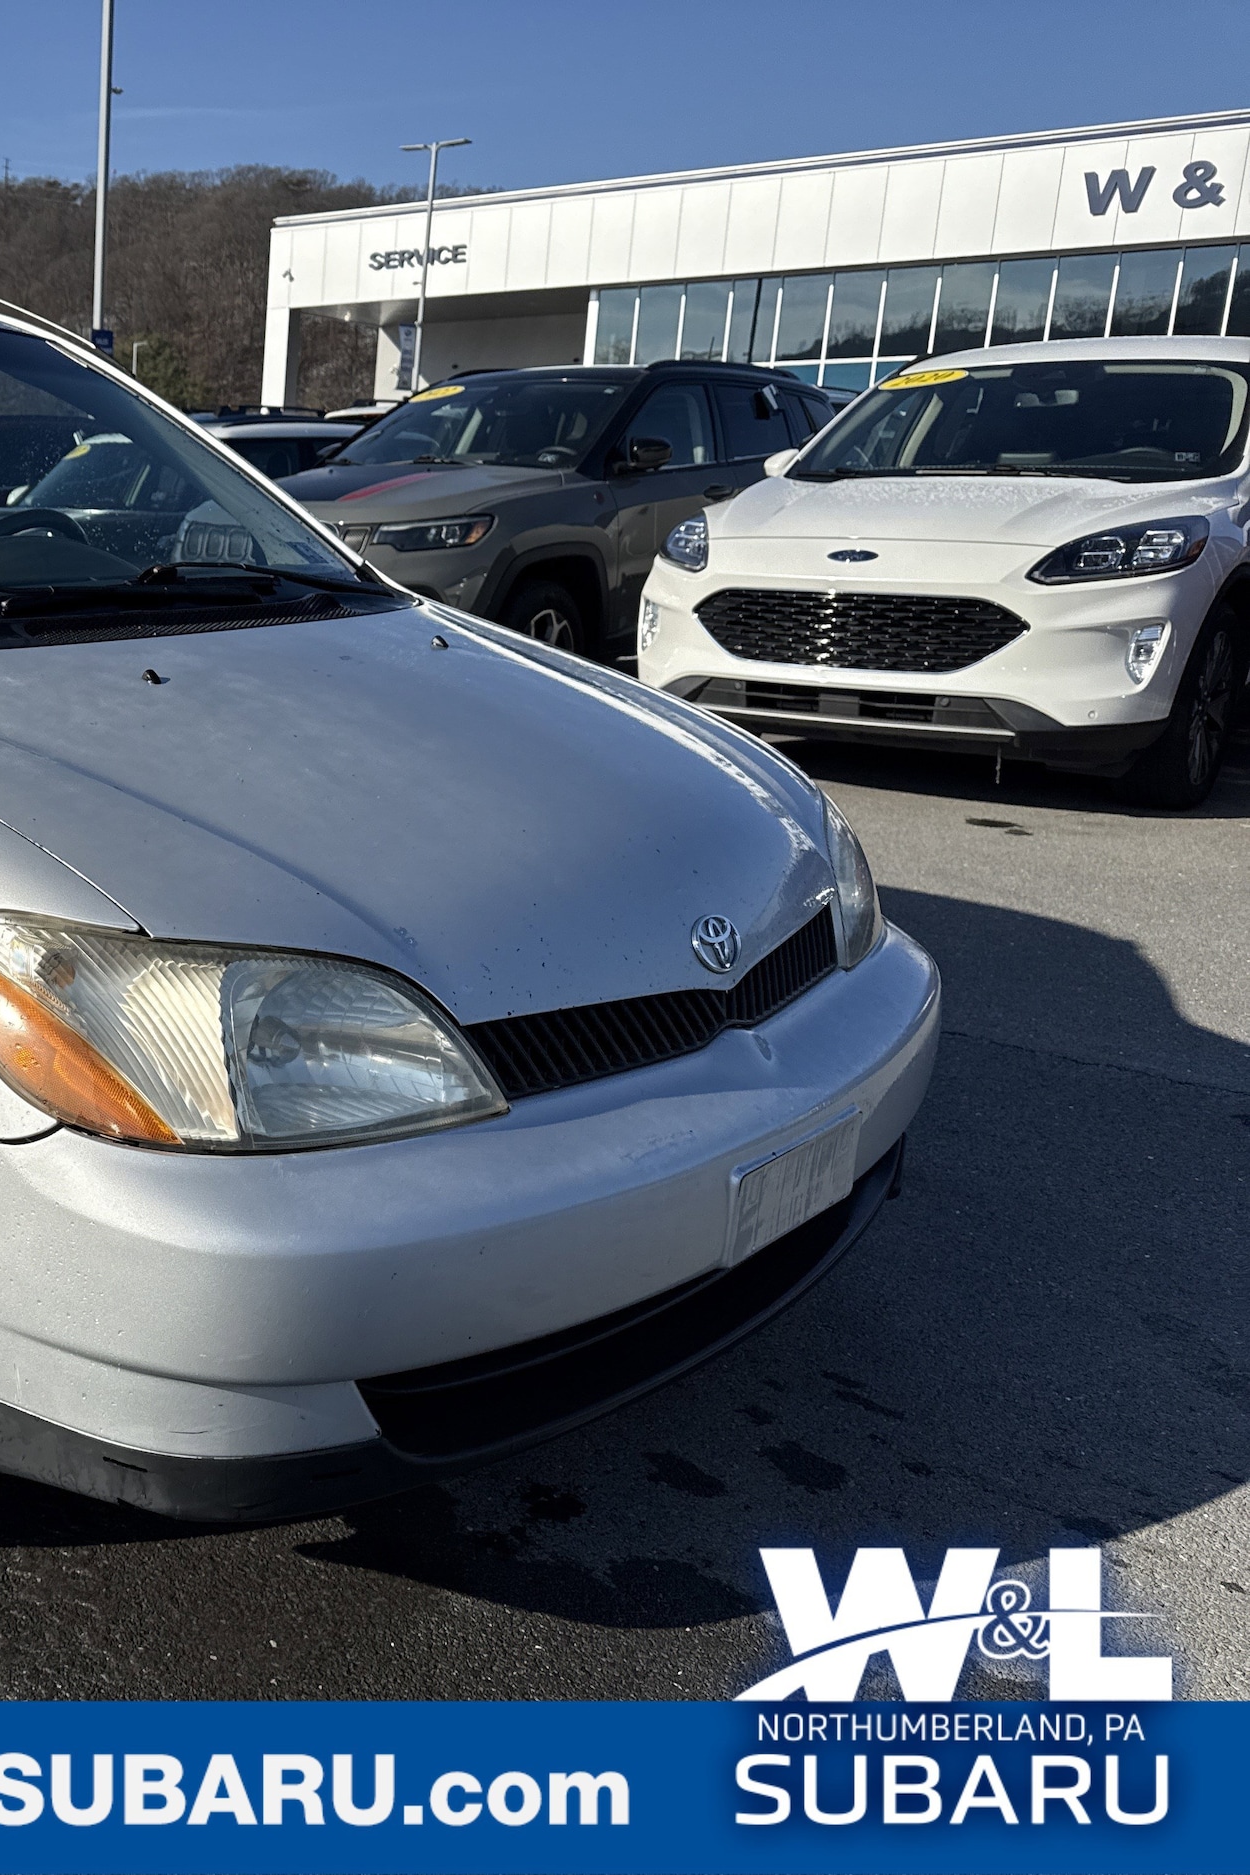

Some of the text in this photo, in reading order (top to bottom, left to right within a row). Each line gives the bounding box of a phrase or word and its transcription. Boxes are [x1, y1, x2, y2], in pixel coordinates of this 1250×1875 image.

[1084, 160, 1226, 216] W &
[369, 244, 468, 271] SERVICE
